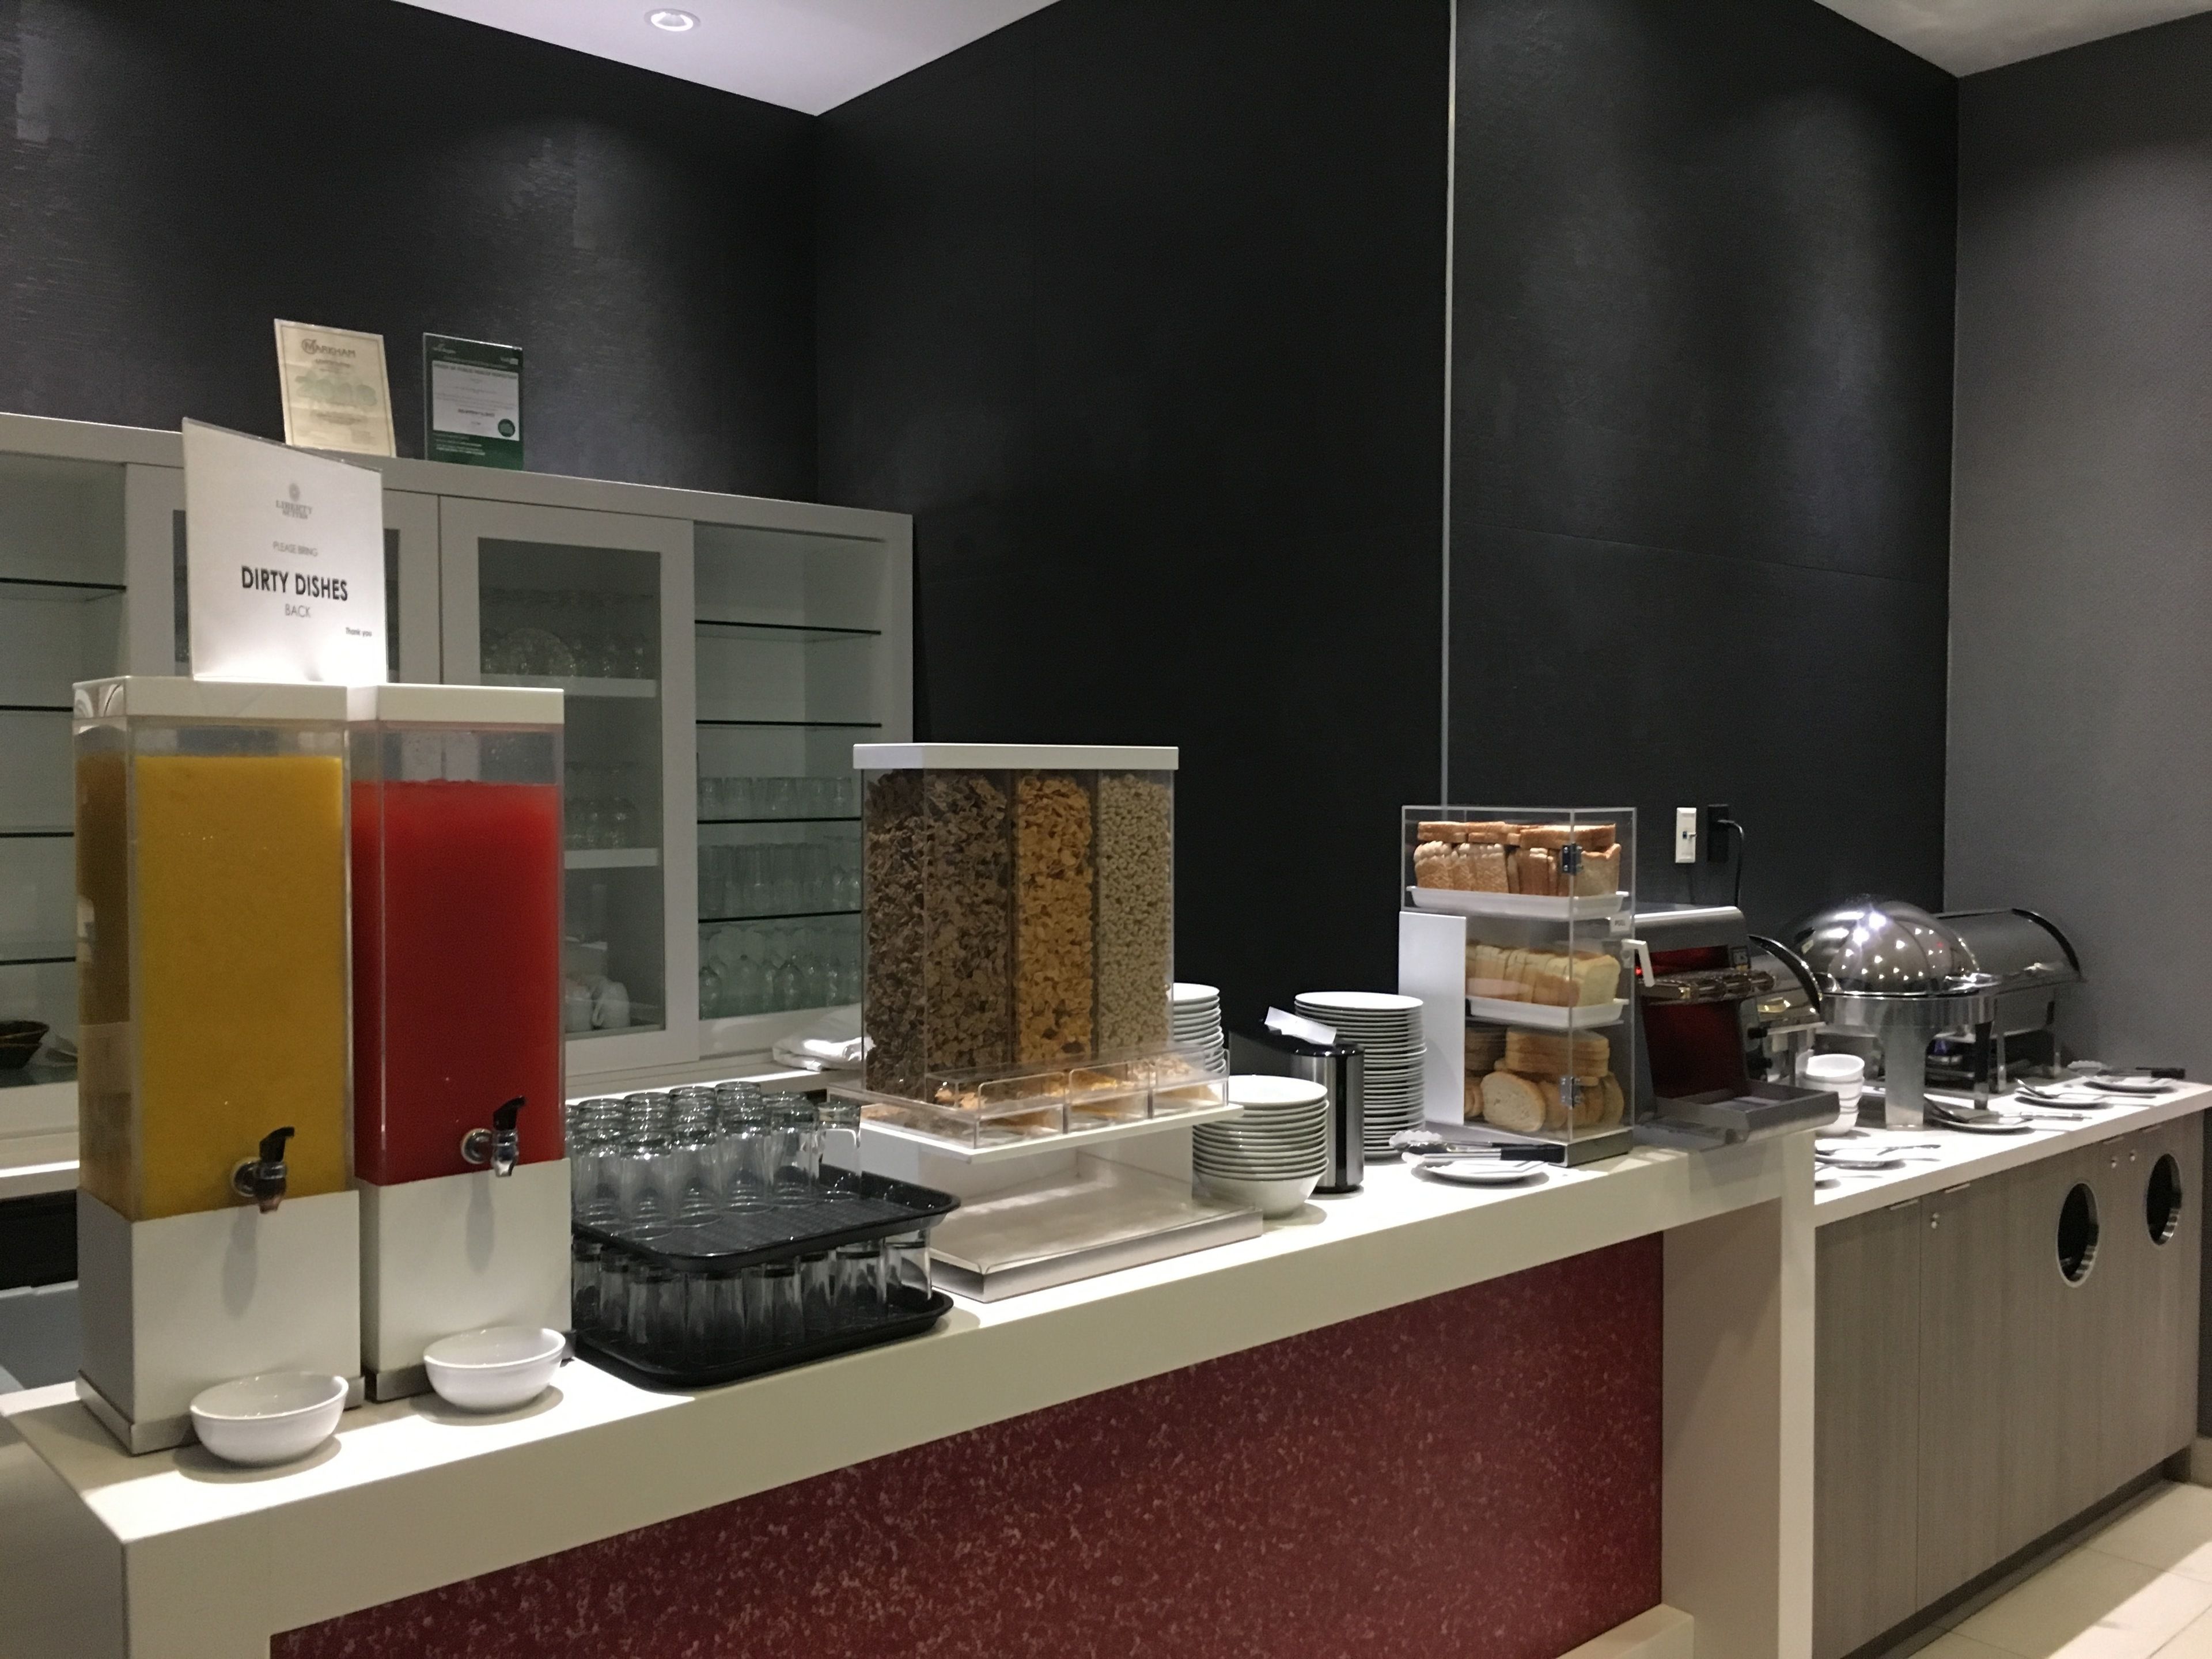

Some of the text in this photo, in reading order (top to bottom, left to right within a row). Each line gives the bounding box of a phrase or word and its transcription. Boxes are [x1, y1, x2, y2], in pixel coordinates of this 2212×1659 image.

[275, 500, 313, 514] LIBERTY
[272, 541, 318, 557] PLEASE BRING
[241, 565, 349, 601] DIRTY DISHES
[285, 604, 311, 618] BACK
[346, 627, 360, 636] Thank
